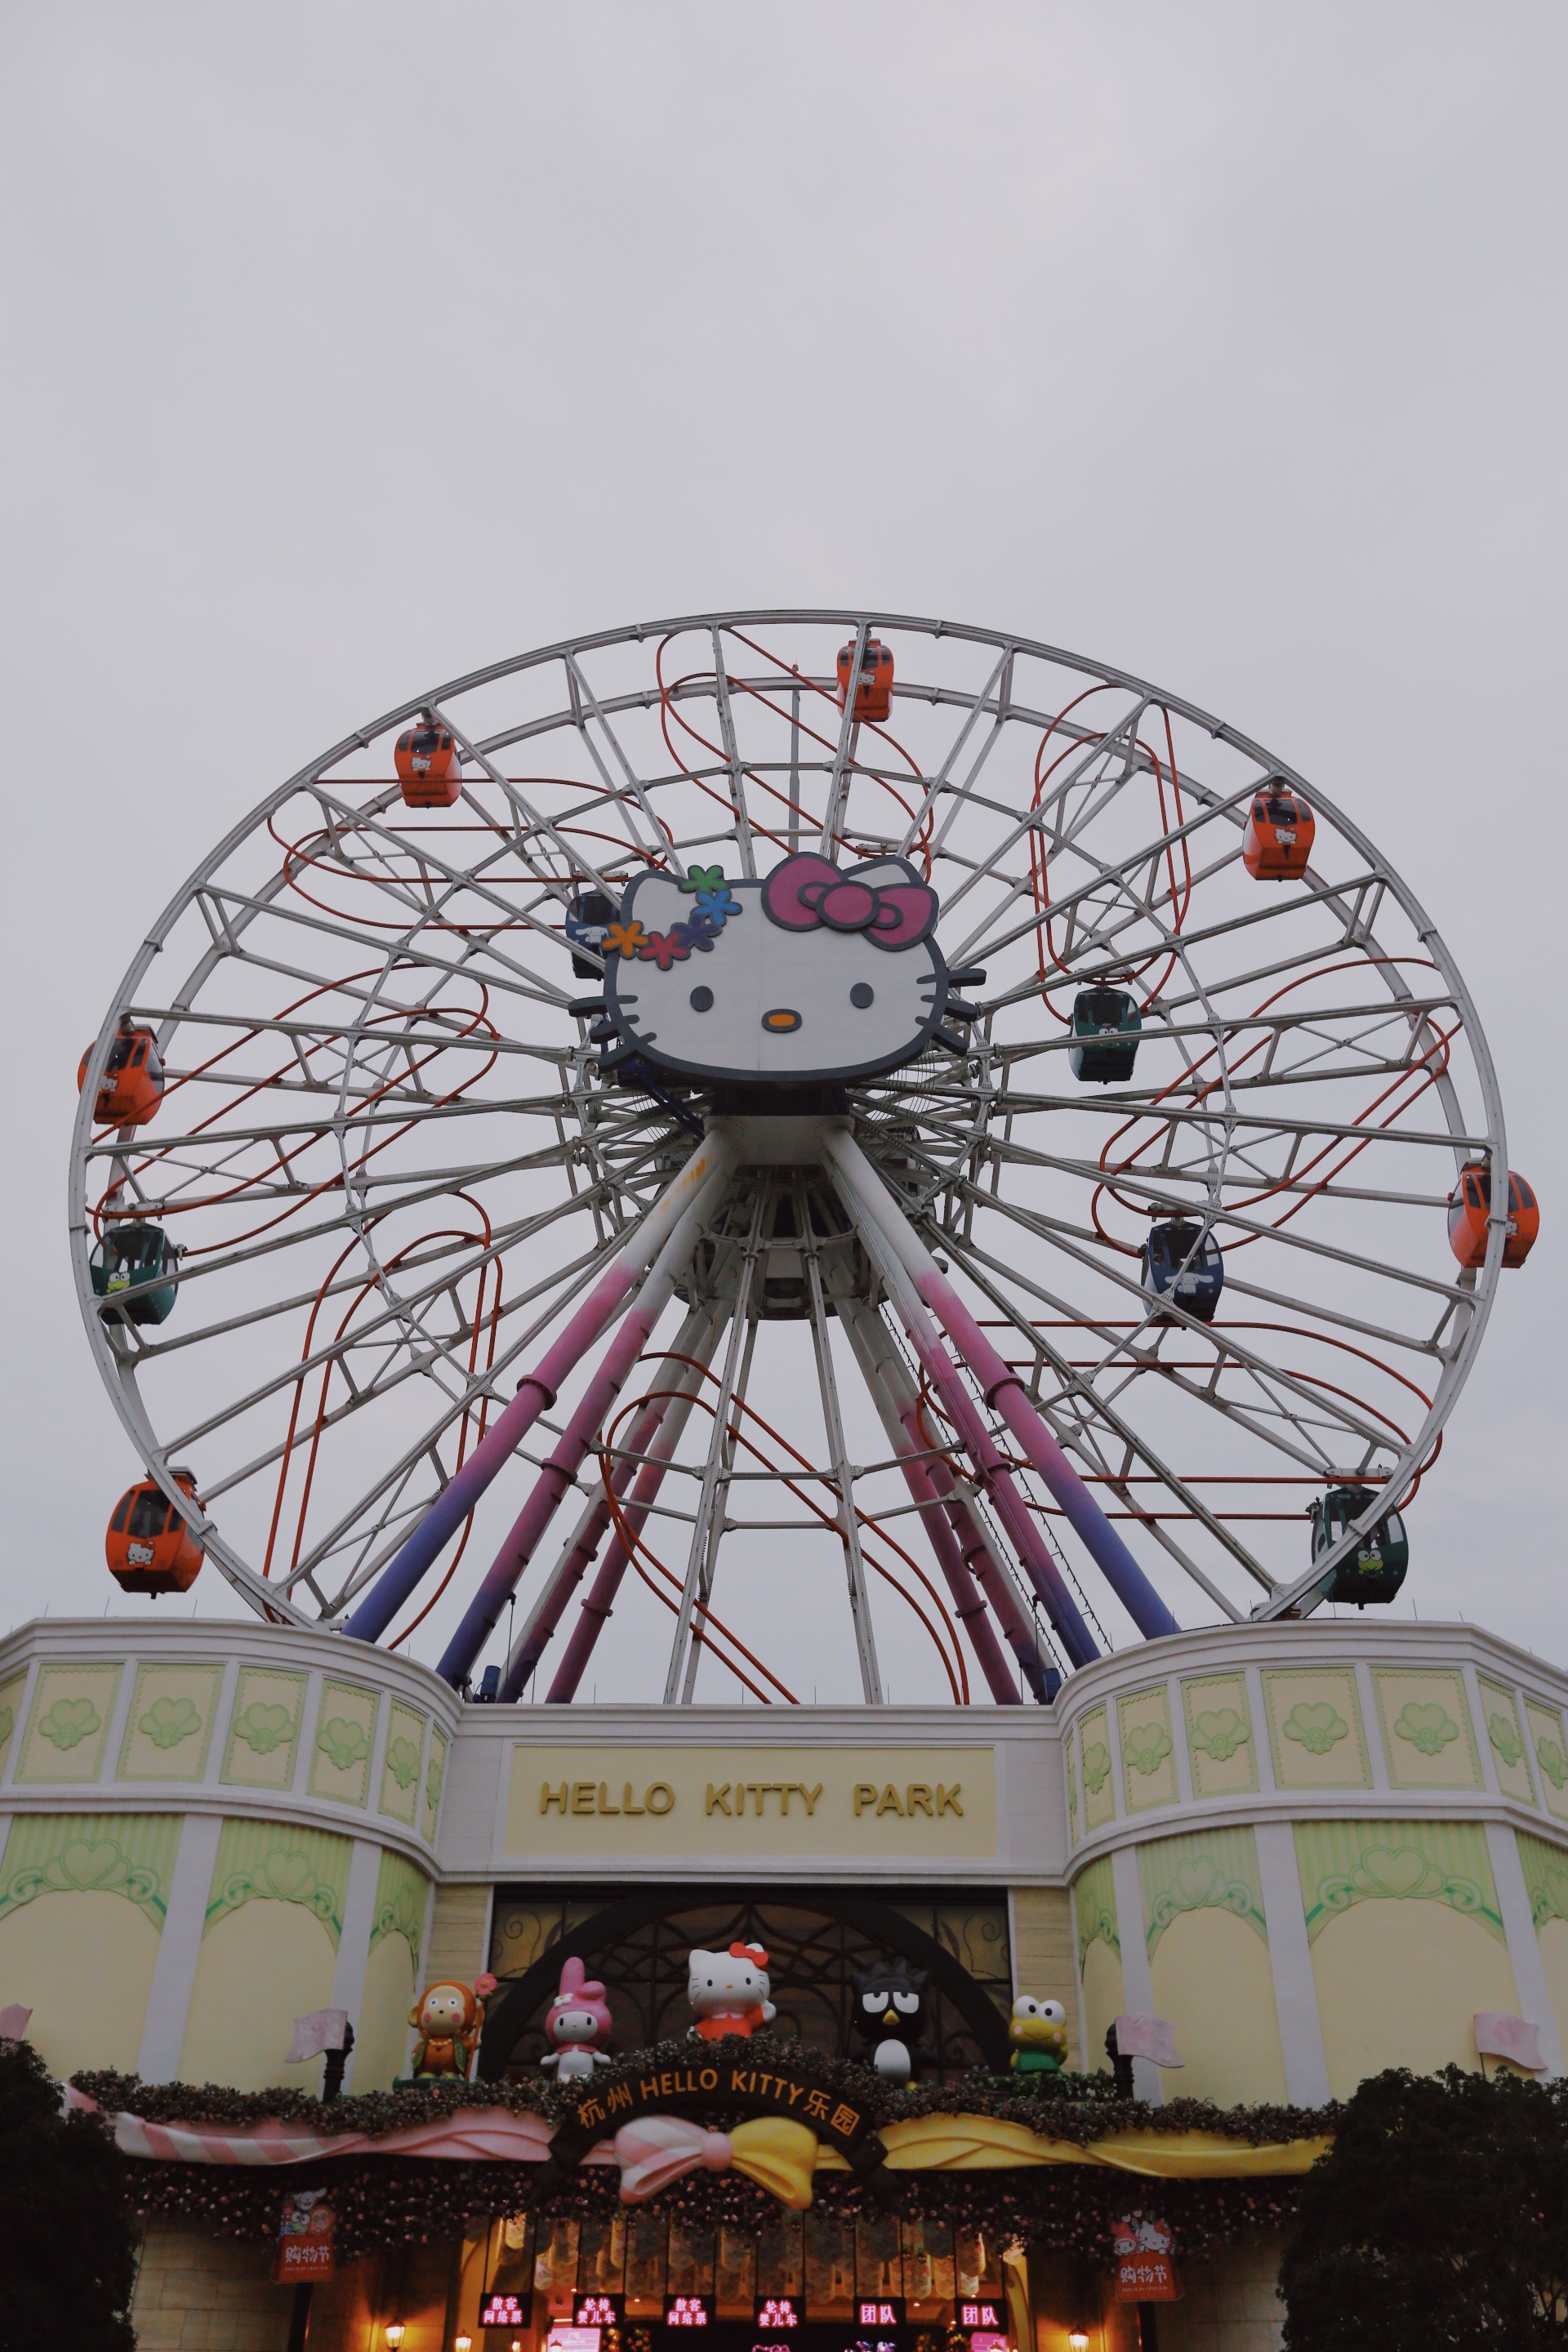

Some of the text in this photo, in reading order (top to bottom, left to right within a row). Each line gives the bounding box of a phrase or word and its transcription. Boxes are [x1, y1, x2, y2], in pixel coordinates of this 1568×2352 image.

[540, 1781, 964, 1817] HELLO KITTY PARK
[577, 2068, 860, 2137] 杭州 HELLO KITTY 乐园
[285, 2244, 330, 2264] 购物节
[1120, 2264, 1167, 2283] 购物节
[492, 2296, 518, 2310] 散客
[585, 2297, 610, 2311] 轮椅
[675, 2298, 702, 2312] 散客
[766, 2301, 791, 2314] 轮椅
[483, 2310, 523, 2323] 网络票
[577, 2310, 616, 2323] 婴儿车
[668, 2311, 706, 2325] 网络票
[759, 2313, 798, 2326] 婴儿车
[861, 2305, 897, 2323] 团队
[963, 2306, 999, 2325] 团队
